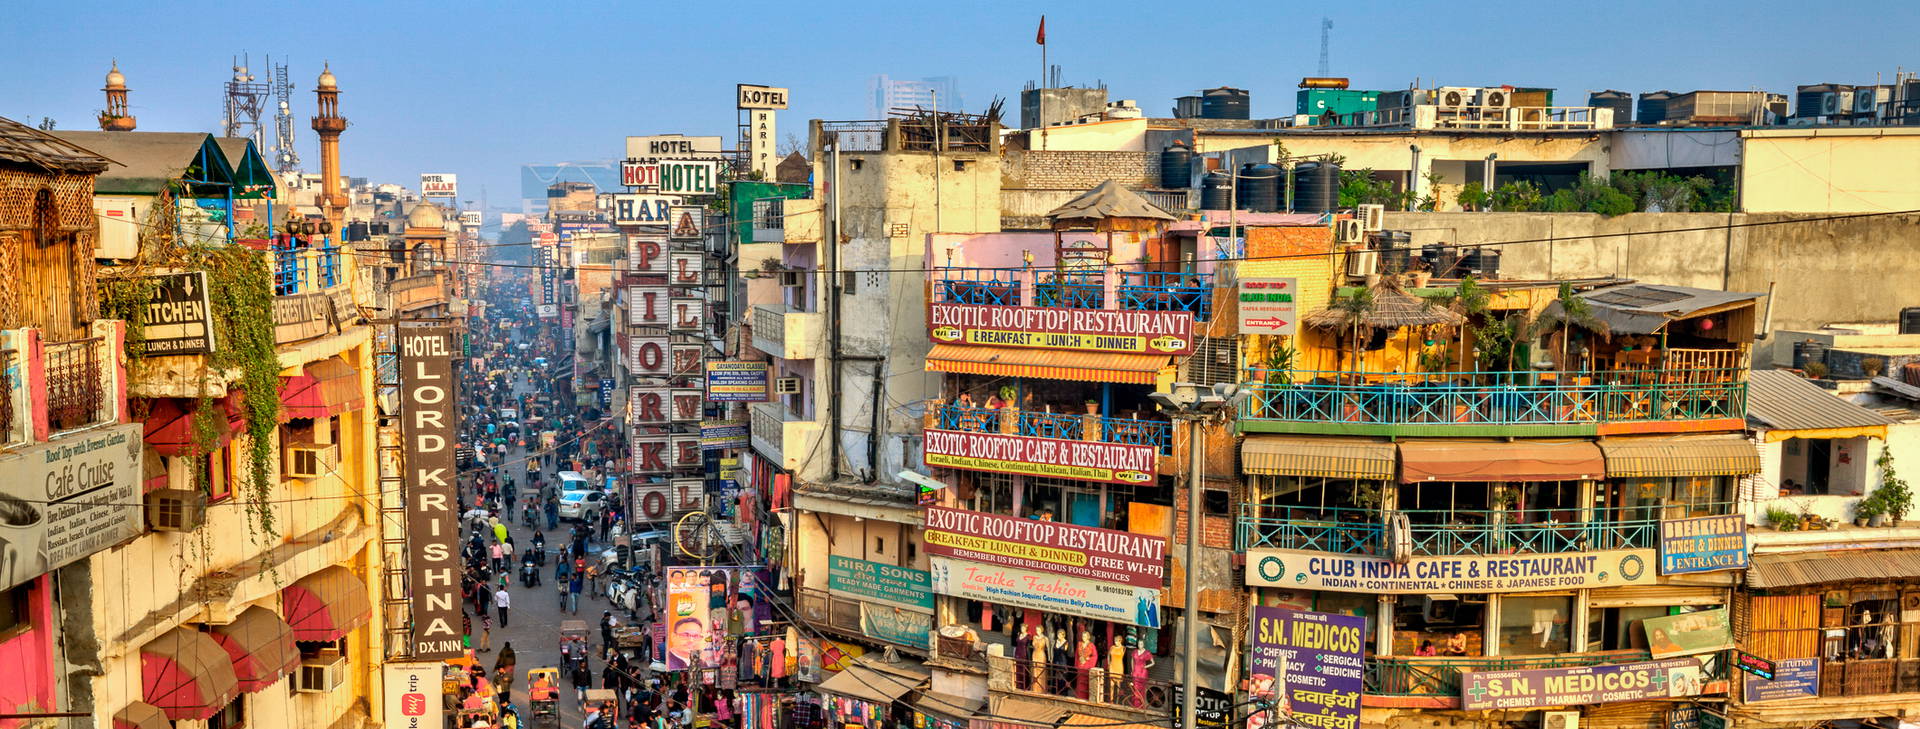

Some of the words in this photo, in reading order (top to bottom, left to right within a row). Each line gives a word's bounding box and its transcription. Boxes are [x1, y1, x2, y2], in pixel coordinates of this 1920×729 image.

[651, 141, 695, 153] HOTEL
[424, 183, 454, 191] AMAN
[660, 163, 715, 193] HOTEL
[616, 199, 682, 222] HAR
[1240, 292, 1265, 302] CLUB
[1266, 292, 1292, 303] INDIA
[144, 300, 204, 325] ITCHEN
[931, 305, 988, 327] EXOTIC
[991, 307, 1069, 330] ROOFTOP
[1073, 311, 1188, 335] RESTAURANT
[147, 341, 171, 352] LUNCH
[172, 341, 178, 350] &
[178, 339, 205, 349] DINNER
[403, 336, 449, 357] HOTEL
[974, 330, 1032, 345] BREAKFAST
[1046, 334, 1081, 347] LUNCH
[1096, 336, 1137, 350] DINNER
[413, 361, 446, 453] LORD
[46, 447, 61, 463] Roof
[62, 445, 73, 461] Top
[73, 441, 86, 455] with
[106, 432, 126, 446] Garden
[926, 431, 967, 456] EXOTIC
[970, 435, 1023, 461] ROOFTOP
[1026, 439, 1057, 463] CAFE
[1060, 442, 1069, 465] &
[1072, 443, 1152, 471] RESTAURANT
[951, 456, 973, 466] Indian,
[974, 459, 999, 469] Chinese,
[46, 464, 74, 500] Café
[78, 458, 114, 490] Cruise
[927, 508, 980, 534] EXOTIC
[982, 516, 1054, 544] ROOFTOP
[1058, 526, 1165, 561] RESTAURANT
[1665, 517, 1742, 538] BREAKFAST
[418, 467, 456, 637] KRISHNA
[927, 531, 986, 549] BREAKFAST
[990, 542, 1026, 555] LUNCH
[1028, 547, 1038, 557] &
[1040, 548, 1084, 564] DINNER
[1665, 538, 1695, 555] LUNCH
[1698, 538, 1705, 552] &
[1708, 535, 1744, 551] DINNER
[838, 559, 876, 573] HIRA
[880, 566, 925, 582] SONS
[953, 548, 996, 562] REMEMBER
[1008, 557, 1024, 566] FOR
[1025, 559, 1067, 572] DELICIOUS
[1068, 566, 1090, 576] FOOD
[1092, 569, 1130, 582] SERVICES
[1089, 555, 1124, 570] (FREE
[1126, 561, 1164, 578] WI-FI)
[1309, 557, 1355, 577] CLUB
[1361, 559, 1410, 579] INDIA
[1416, 561, 1462, 579] CAFE
[1468, 560, 1480, 578] &
[1487, 556, 1597, 577] RESTAURANT
[1676, 555, 1734, 569] ENTRANCE
[837, 576, 861, 586] READY
[862, 582, 882, 591] MADE
[884, 585, 925, 599] GARMENTS
[964, 567, 1016, 587] Tanika
[1023, 575, 1087, 598] Fashion
[1322, 577, 1357, 589] INDIAN
[1366, 580, 1439, 590] CONTINENTAL
[1448, 580, 1493, 589] CHINESE
[1496, 580, 1503, 588] &
[1507, 577, 1556, 588] JAPANESE
[1559, 576, 1585, 586] FOOD
[986, 586, 999, 595] High
[1000, 588, 1021, 597] Fashion
[1042, 594, 1069, 604] Garments
[1070, 598, 1085, 607] Belly
[1085, 601, 1104, 610] Dance
[1104, 604, 1125, 613] Dresses
[419, 639, 462, 654] DX.INN
[1259, 617, 1288, 645] S.N.
[1292, 620, 1360, 654] MEDICOS
[1263, 647, 1298, 659] CHEMIST
[1323, 654, 1362, 667] SERGICAL
[408, 674, 419, 692] trip
[1286, 673, 1327, 686] COSMETIC
[1322, 666, 1361, 679] MEDICINE
[1488, 677, 1537, 698] S.N.
[1544, 670, 1650, 695] MEDICOS
[1497, 697, 1536, 707] CHEMIST
[1546, 694, 1593, 705] PHARMACY
[1602, 690, 1643, 702] COSMETIC
